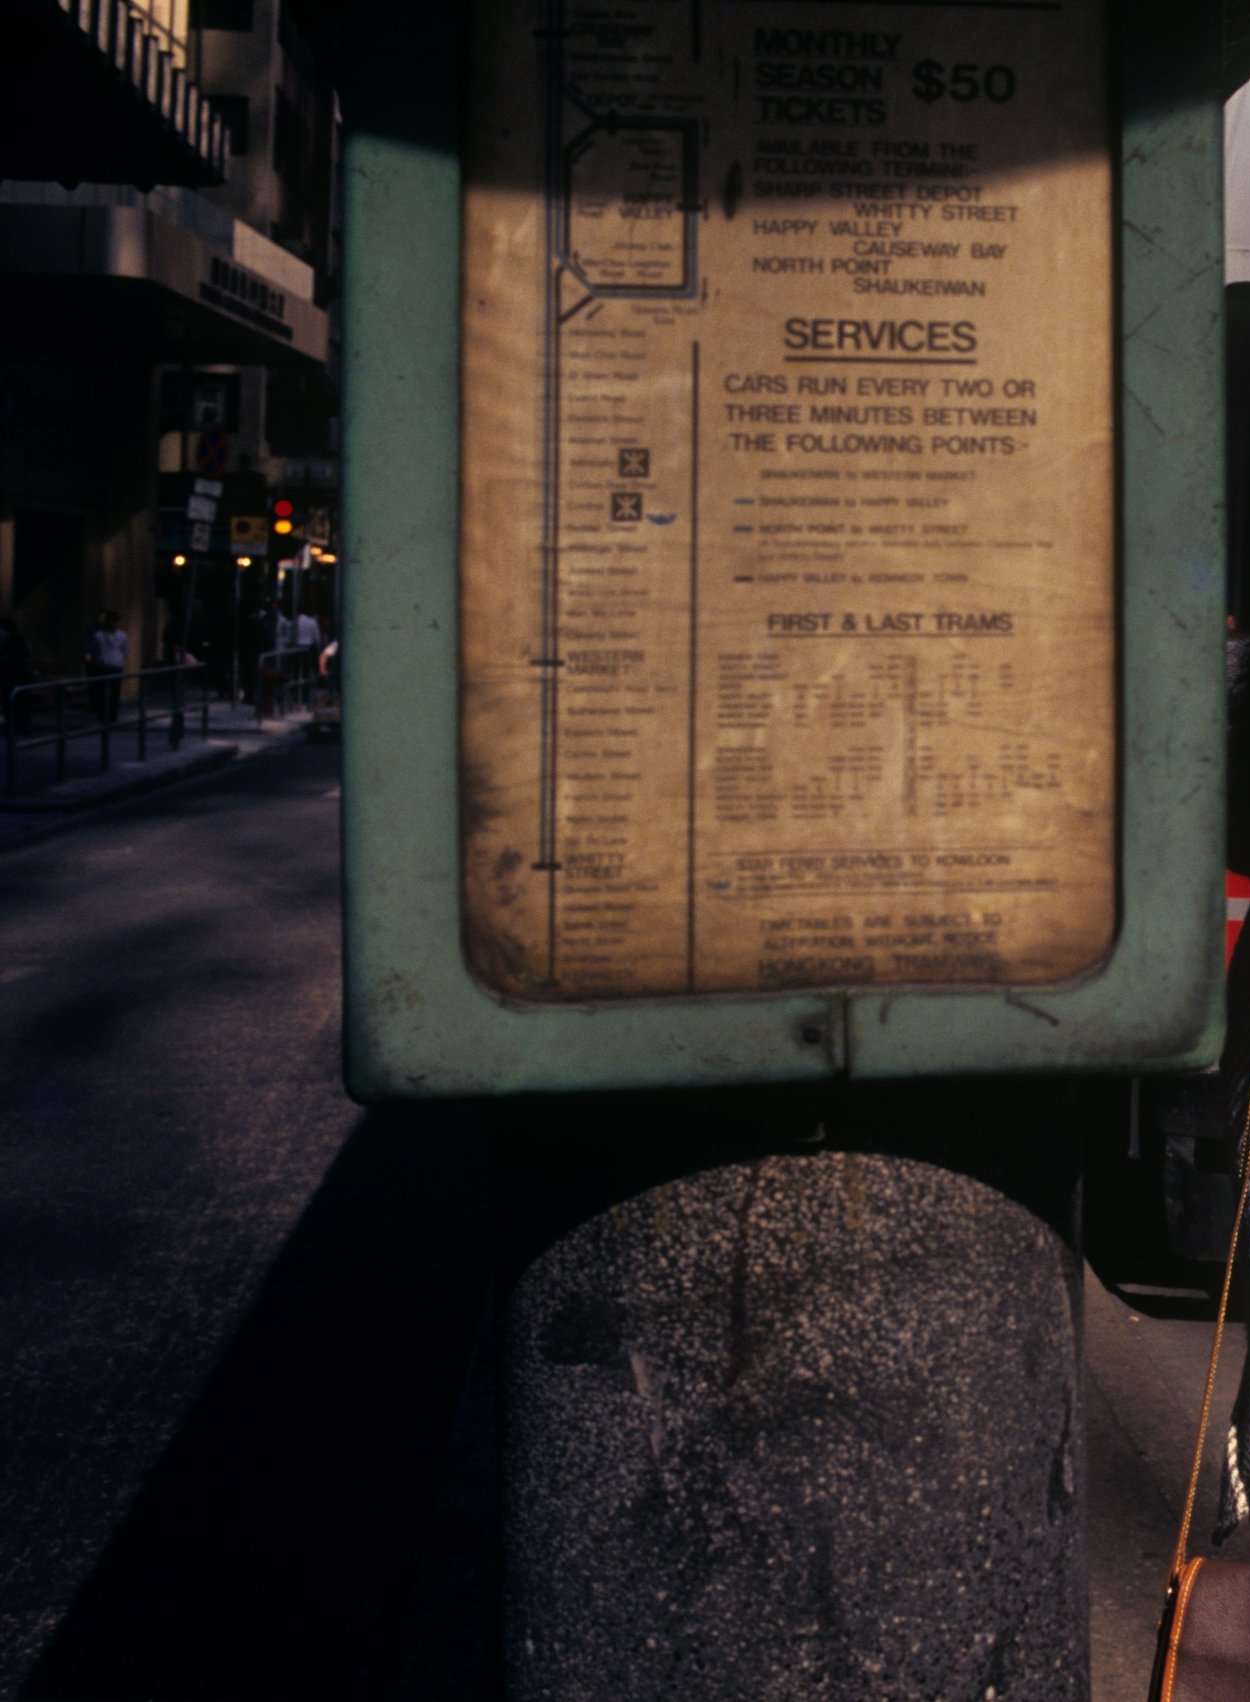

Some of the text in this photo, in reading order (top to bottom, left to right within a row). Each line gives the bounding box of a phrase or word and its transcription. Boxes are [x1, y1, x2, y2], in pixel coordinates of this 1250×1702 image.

[755, 28, 902, 58] MONTHLY
[754, 61, 883, 92] SEASON
[911, 58, 1017, 104] $50
[755, 94, 887, 125] TICKETS
[755, 139, 977, 159] AVAILABLE FROM THE
[753, 158, 873, 177] FOLLOWING
[753, 181, 982, 202] SHARP STREET DEPOT
[853, 201, 1020, 222] WHITTY STREET
[752, 219, 903, 237] HAPPY VALLEY
[853, 240, 1008, 260] CAUSEWAY BAY
[752, 257, 892, 275] NORTH POINT
[853, 278, 987, 297] SHAUKEIWAN
[783, 318, 977, 353] SERVICES
[723, 374, 1036, 399] CARS RUN EVERY TWO OR
[724, 403, 1037, 427] THREE MINUTES BETWEEN
[730, 432, 777, 453] THE
[786, 433, 923, 455] FOLLOWING
[766, 613, 1015, 634] FIRST & LAST TRAMS
